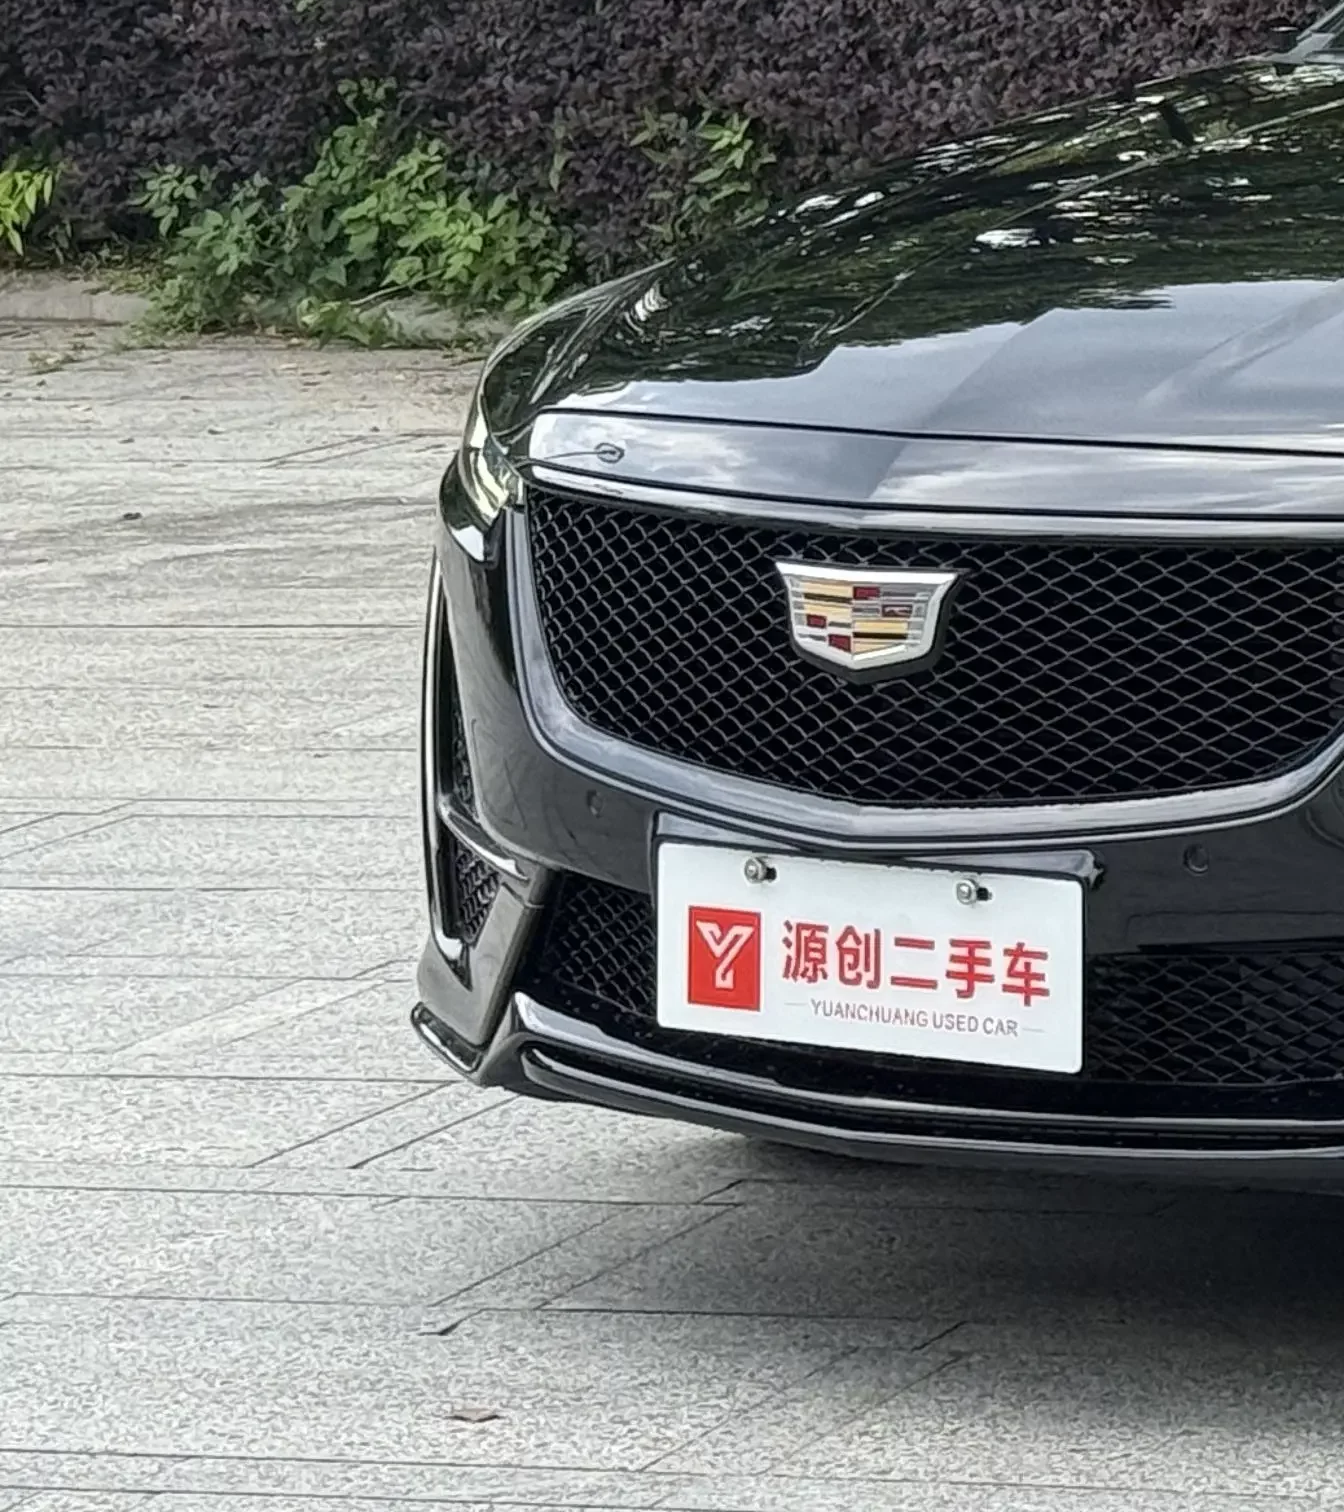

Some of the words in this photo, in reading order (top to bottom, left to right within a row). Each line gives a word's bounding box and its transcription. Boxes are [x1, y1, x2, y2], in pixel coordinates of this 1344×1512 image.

[782, 919, 1050, 1007] 源创二手车
[810, 998, 928, 1028] YUANCHUANG
[932, 1014, 979, 1034] USED
[983, 1017, 1018, 1037] CAR
